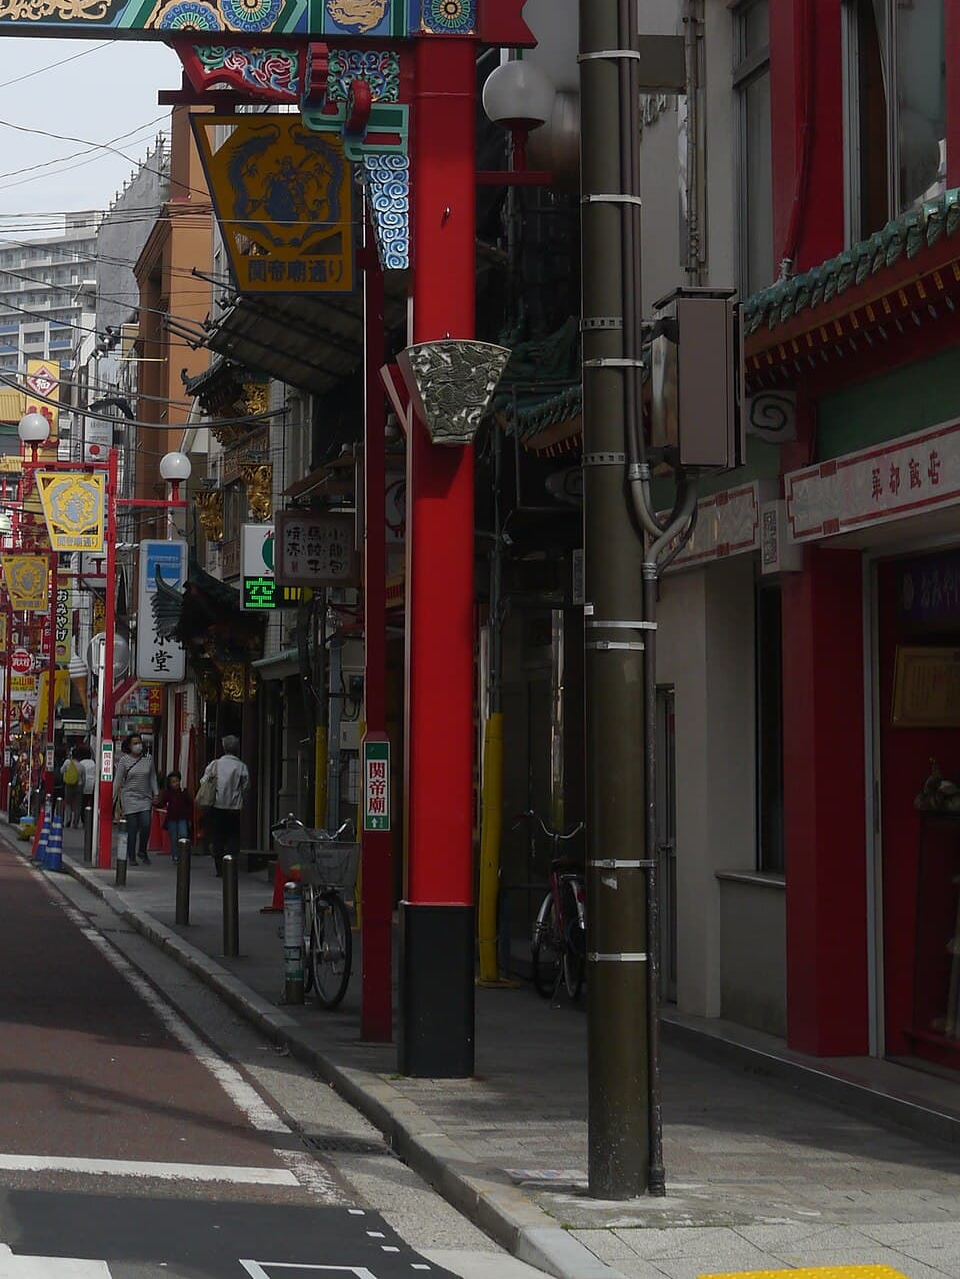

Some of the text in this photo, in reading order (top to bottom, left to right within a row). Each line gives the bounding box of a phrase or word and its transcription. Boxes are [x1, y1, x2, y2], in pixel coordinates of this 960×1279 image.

[55, 589, 69, 642] おみやげ
[245, 577, 276, 608] 空
[368, 762, 386, 814] 関帝廟
